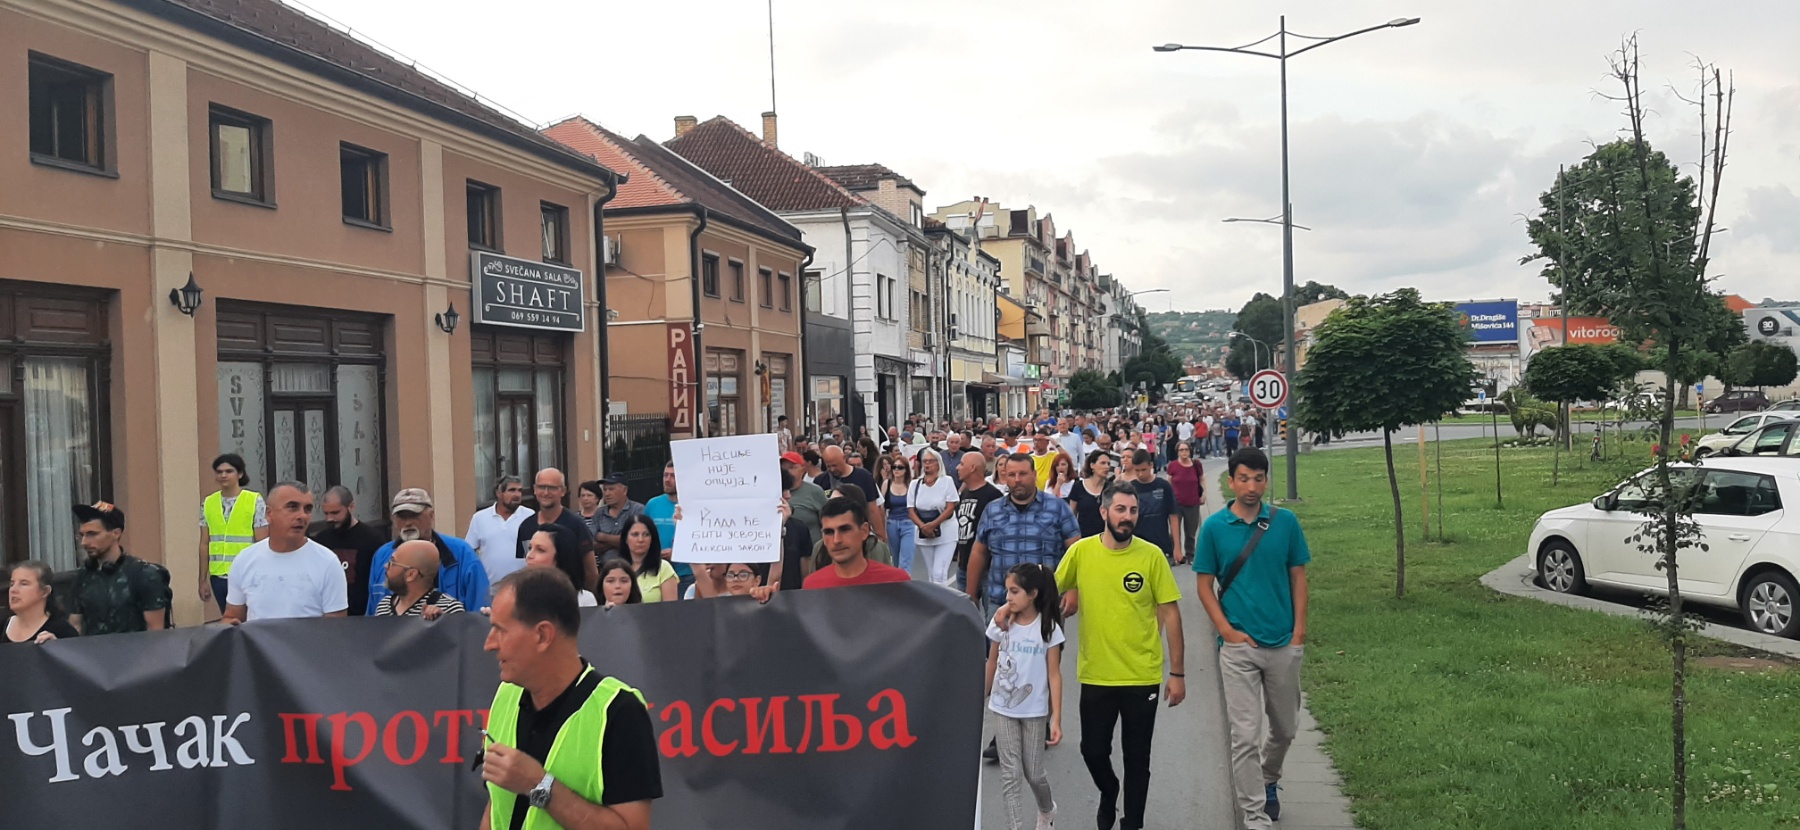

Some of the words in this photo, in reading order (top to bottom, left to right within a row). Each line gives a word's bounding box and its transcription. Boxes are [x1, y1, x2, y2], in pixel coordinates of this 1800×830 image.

[505, 264, 541, 279] SVEČANA
[544, 271, 562, 283] SALA
[496, 281, 570, 310] SHAFT
[511, 311, 524, 320] 069
[527, 312, 539, 322] 559
[542, 314, 550, 323] 14
[671, 328, 690, 427] РАПИД
[1256, 380, 1280, 399] 30
[8, 707, 255, 783] Чачак
[278, 709, 490, 791] прот
[647, 688, 918, 759] асиља
